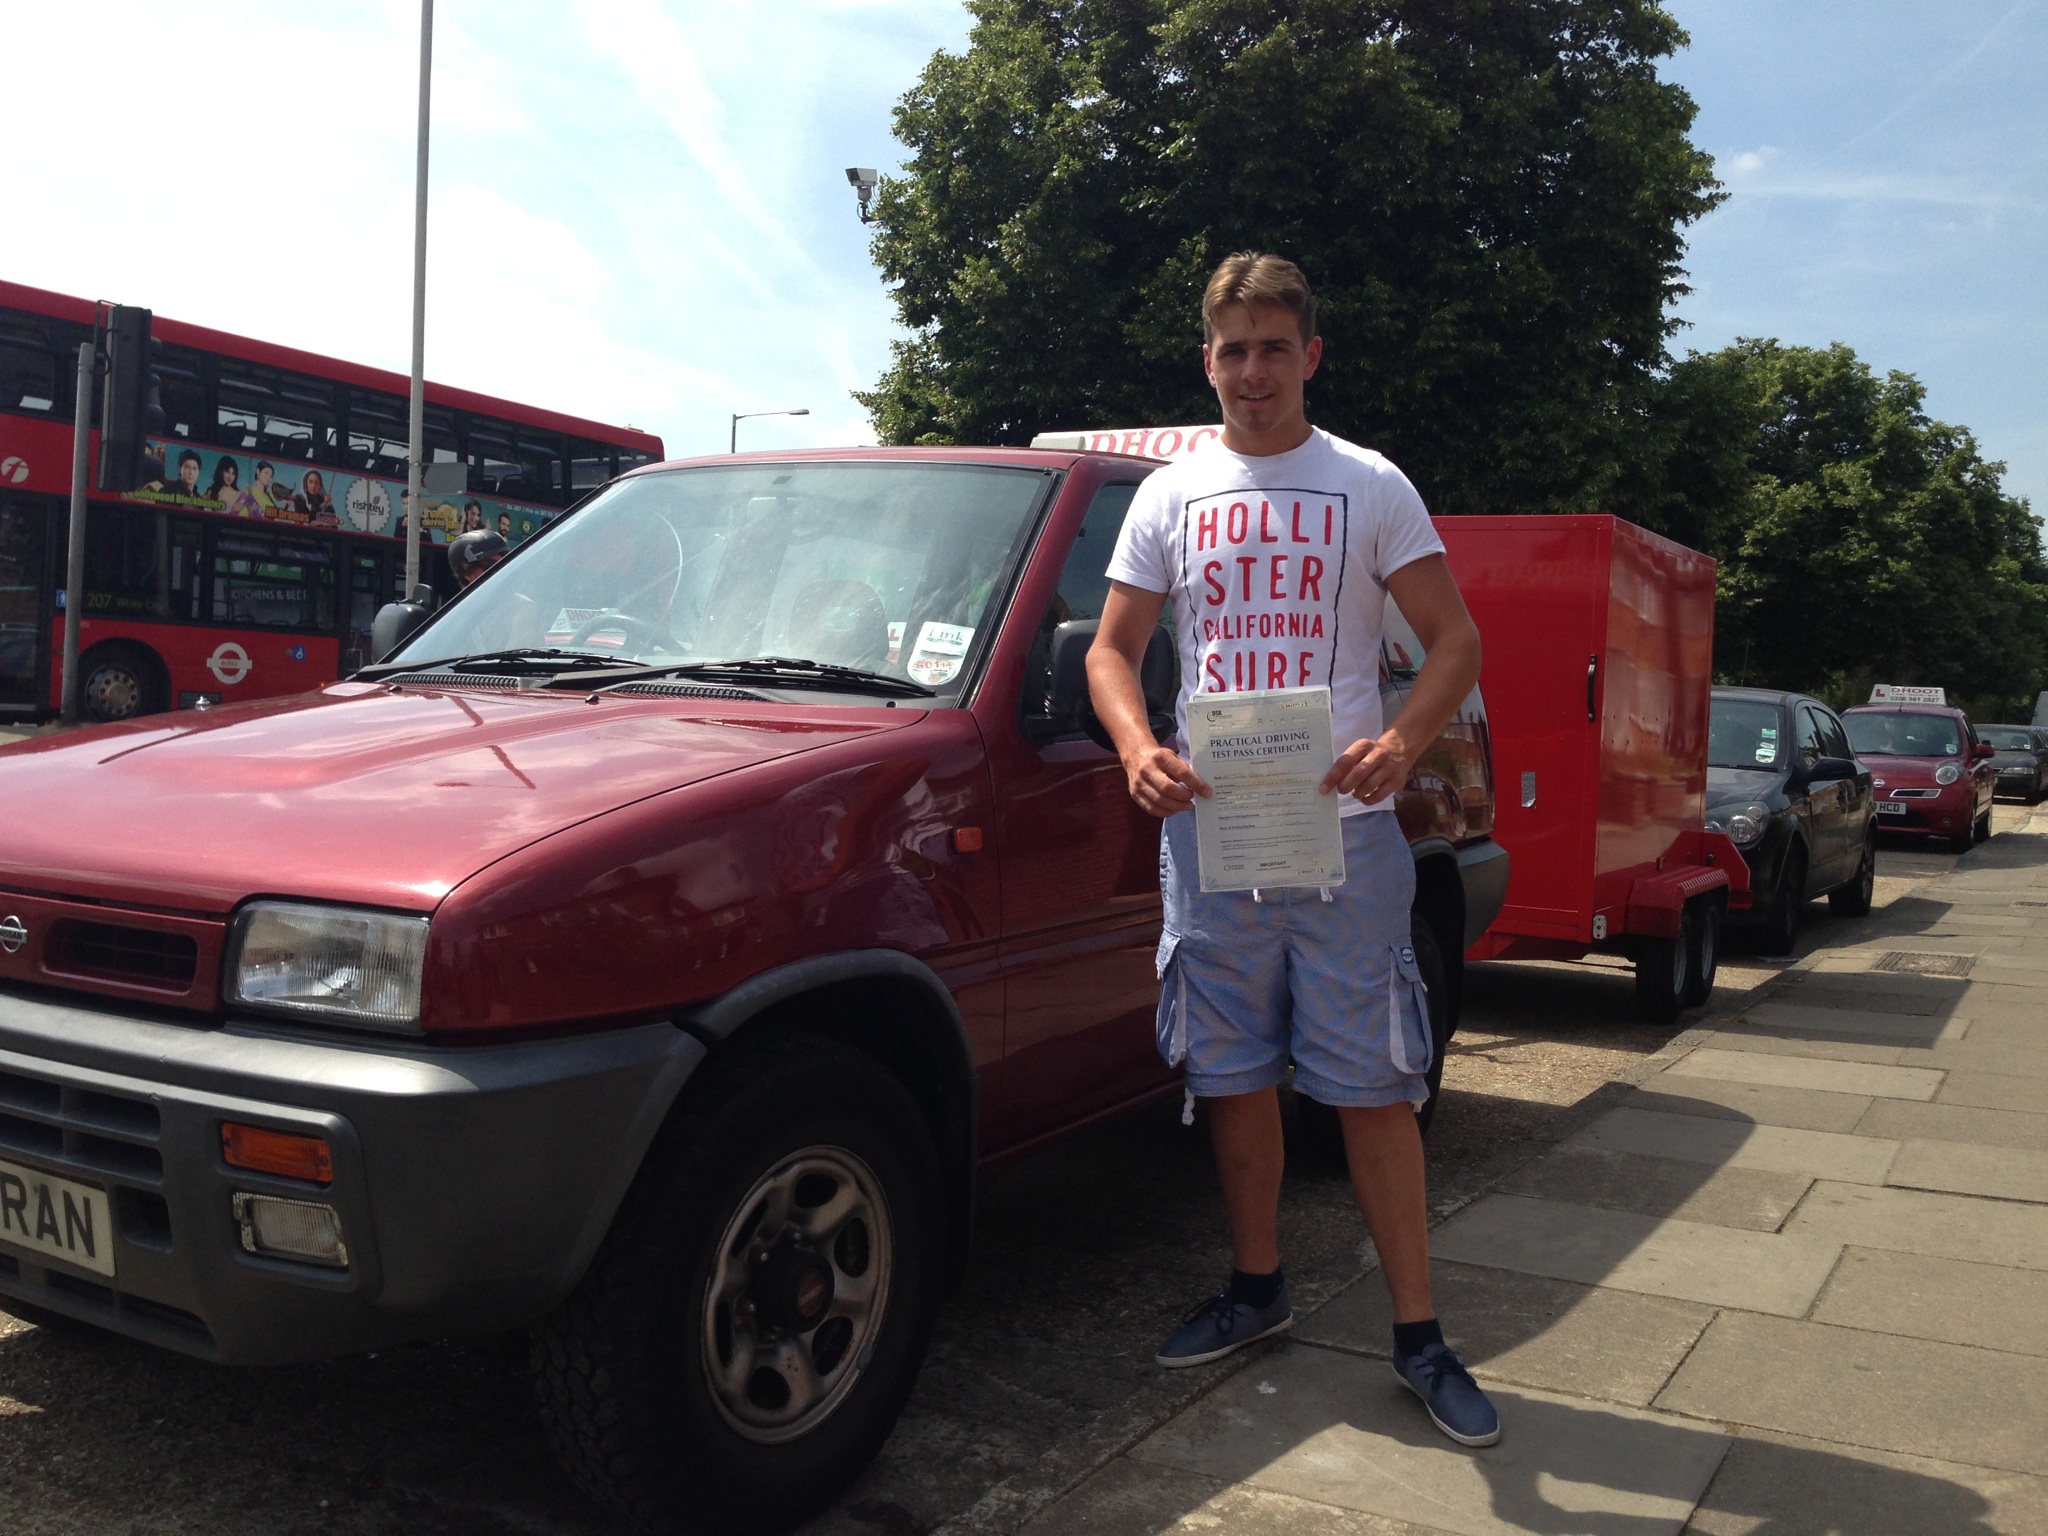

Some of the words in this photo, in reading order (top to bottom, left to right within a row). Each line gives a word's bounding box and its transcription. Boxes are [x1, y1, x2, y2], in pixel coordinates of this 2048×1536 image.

[352, 499, 385, 516] rishtey
[1197, 500, 1333, 551] HOLLI
[1203, 554, 1324, 606] STER
[87, 592, 113, 608] 207
[1203, 612, 1324, 642] CALIFORNIA
[1206, 651, 1314, 693] SURF
[1210, 736, 1264, 748] PRACTICAL
[1265, 731, 1310, 744] DRIVING
[1212, 750, 1231, 759] TEST
[1233, 748, 1254, 757] PASS
[1256, 743, 1311, 755] CERTIFICATE
[1879, 802, 1900, 812] HCD
[0, 1170, 96, 1258] RAN
